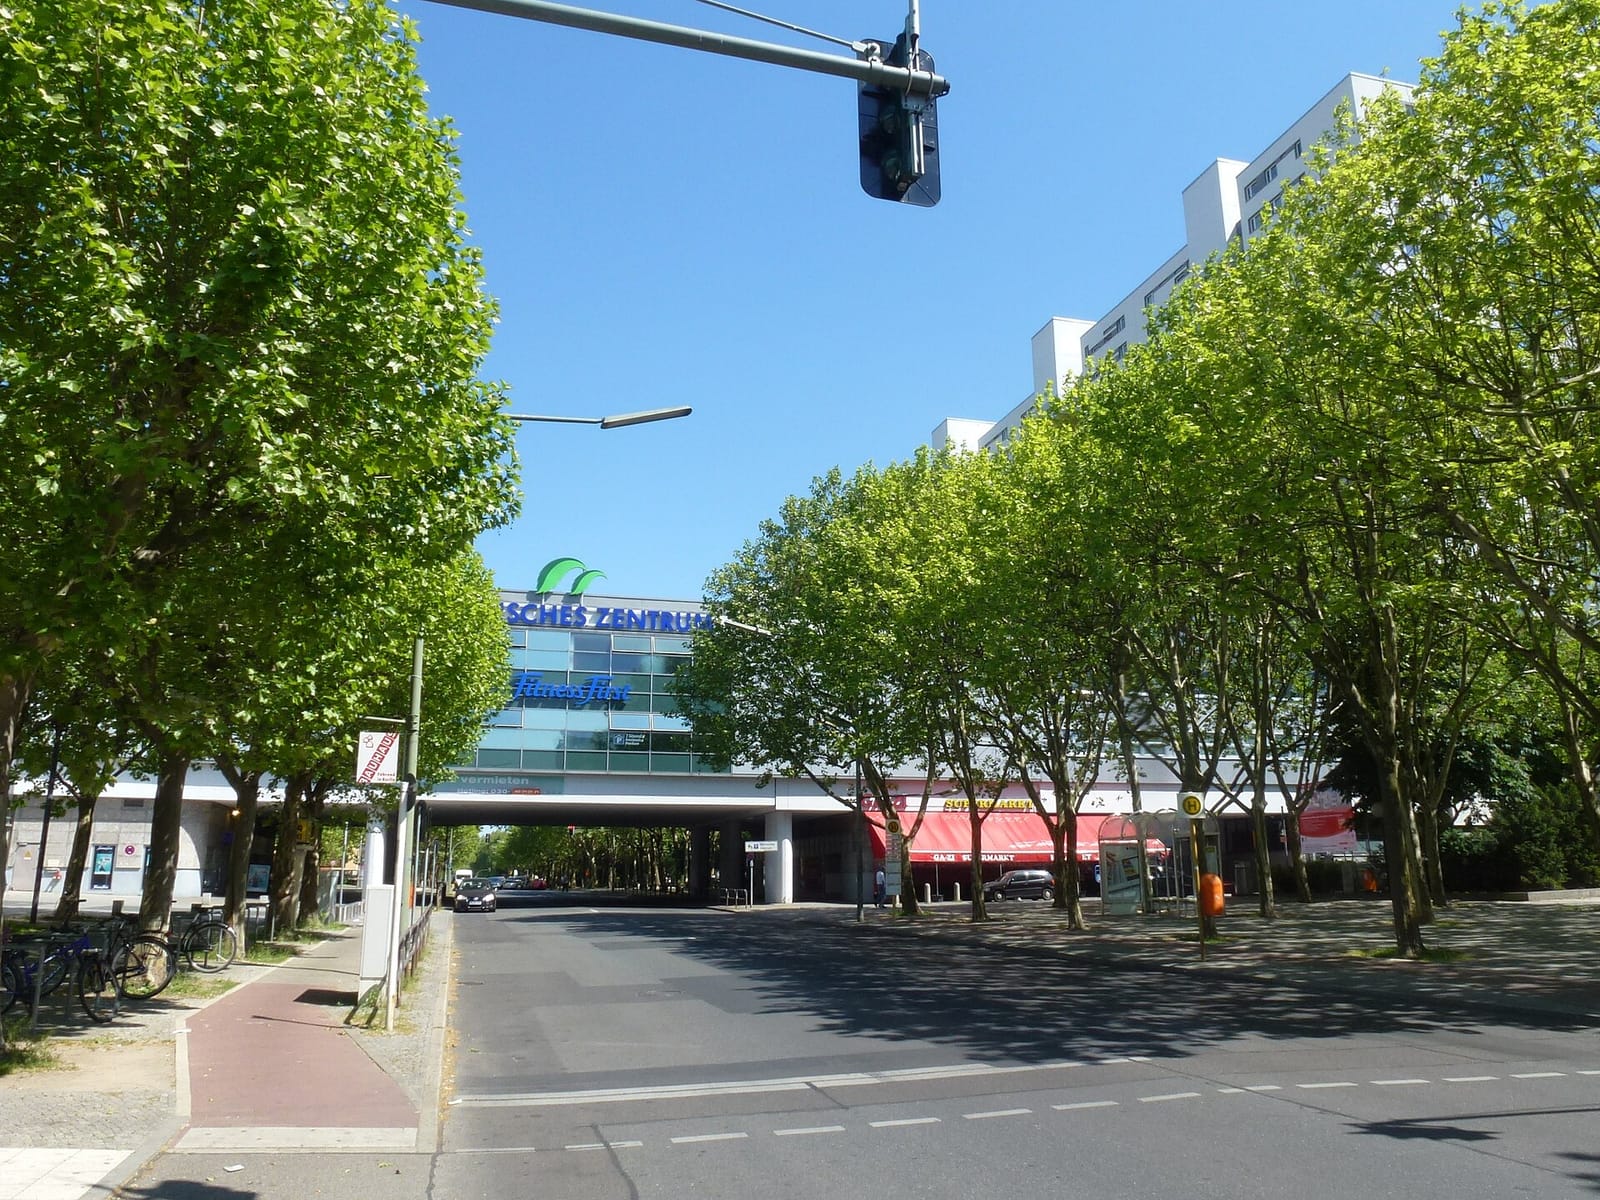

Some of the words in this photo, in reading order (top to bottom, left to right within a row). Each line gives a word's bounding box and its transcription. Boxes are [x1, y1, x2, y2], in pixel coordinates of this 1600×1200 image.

[501, 602, 587, 627] SCHES
[596, 608, 712, 633] ZENTRUM
[513, 671, 583, 701] Fitness
[575, 675, 632, 705] First
[461, 775, 529, 785] vermieten
